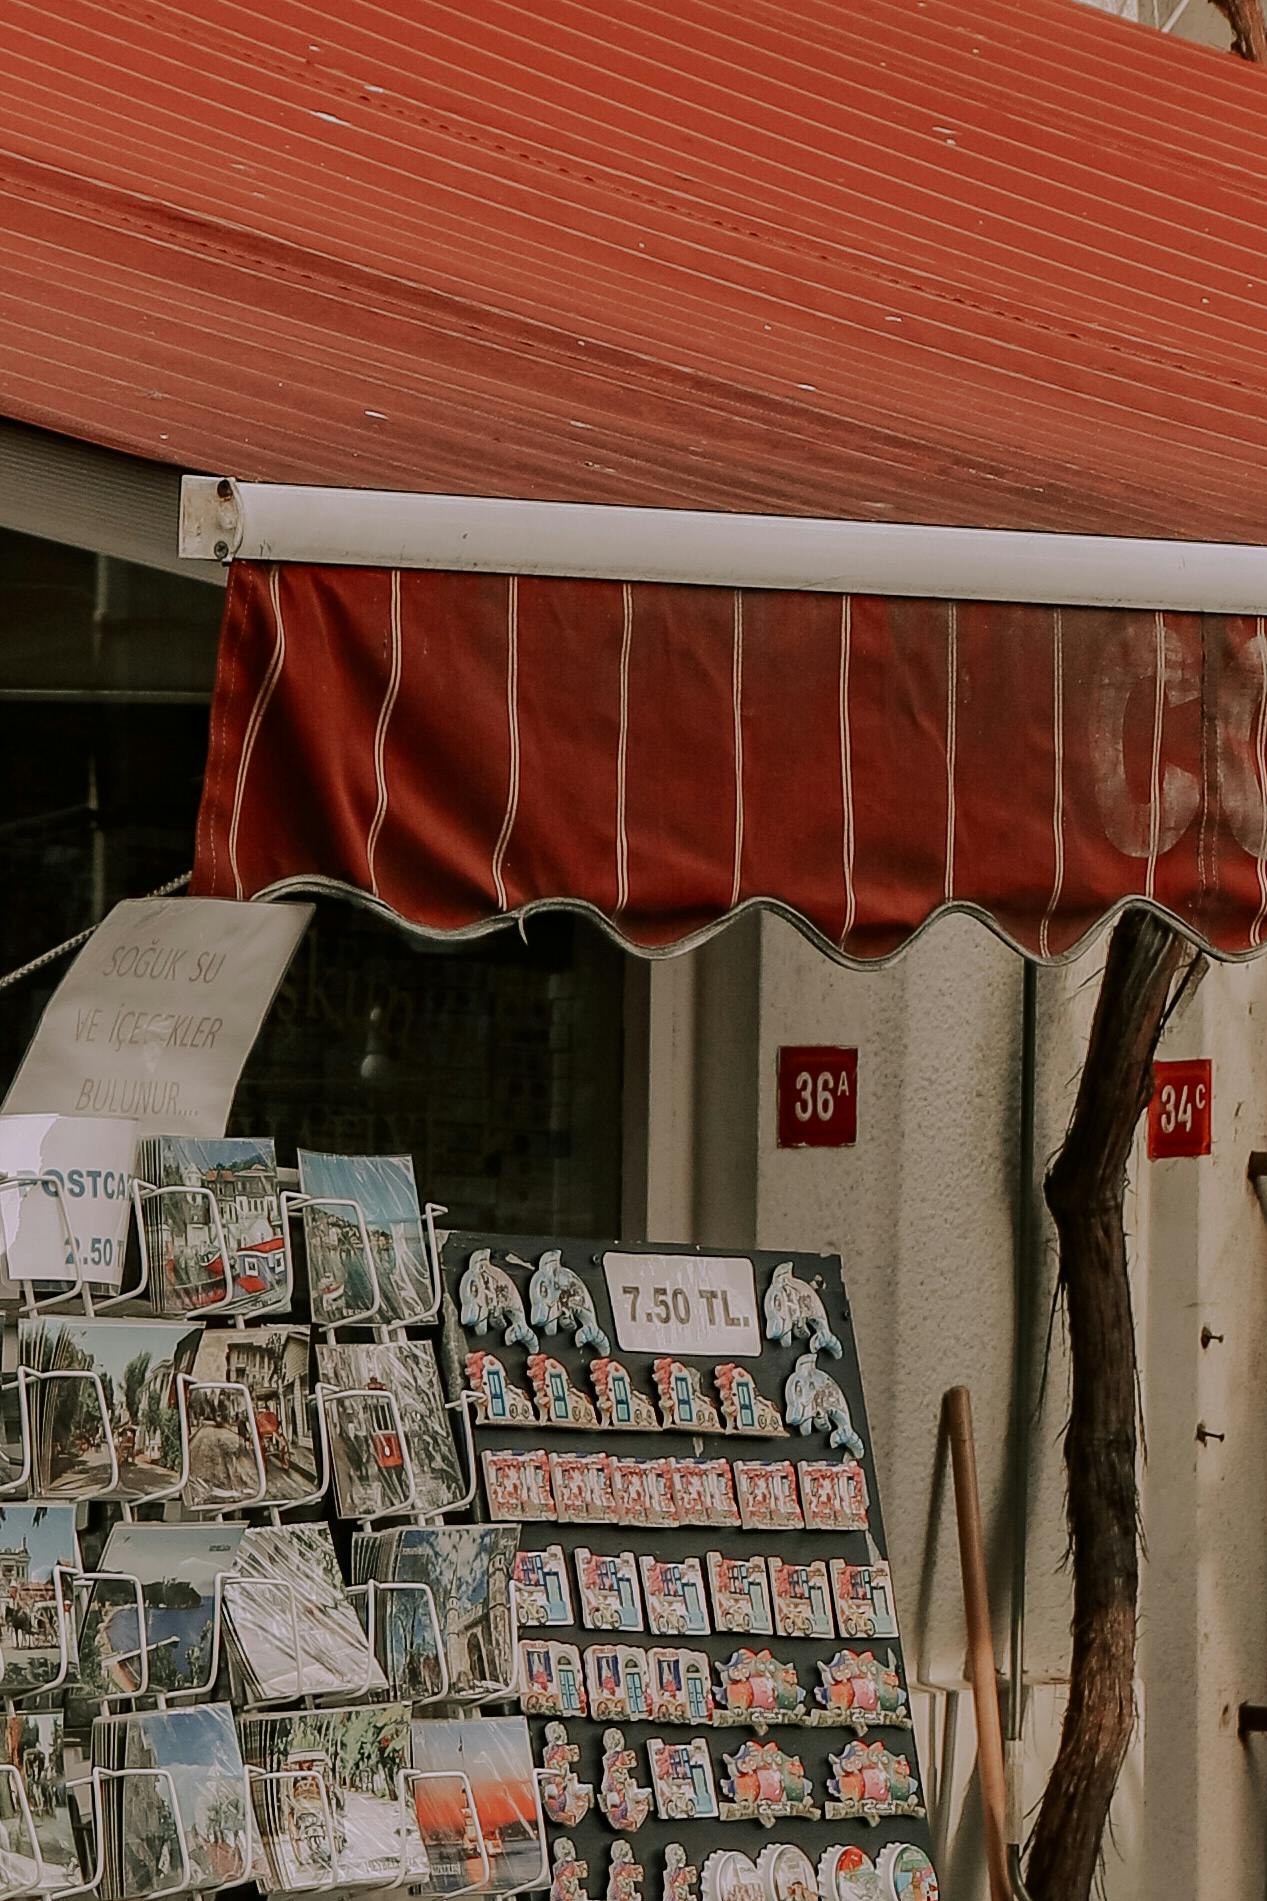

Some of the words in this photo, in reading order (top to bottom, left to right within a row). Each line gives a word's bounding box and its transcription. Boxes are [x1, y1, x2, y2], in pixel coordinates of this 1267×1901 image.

[103, 938, 189, 981] SOĞUK
[188, 951, 227, 984] SU
[75, 1007, 103, 1042] VE
[16, 1168, 132, 1201] POSTCA
[64, 1237, 113, 1267] 2.50
[622, 1285, 692, 1327] 7.50
[700, 1288, 751, 1328] TL.
